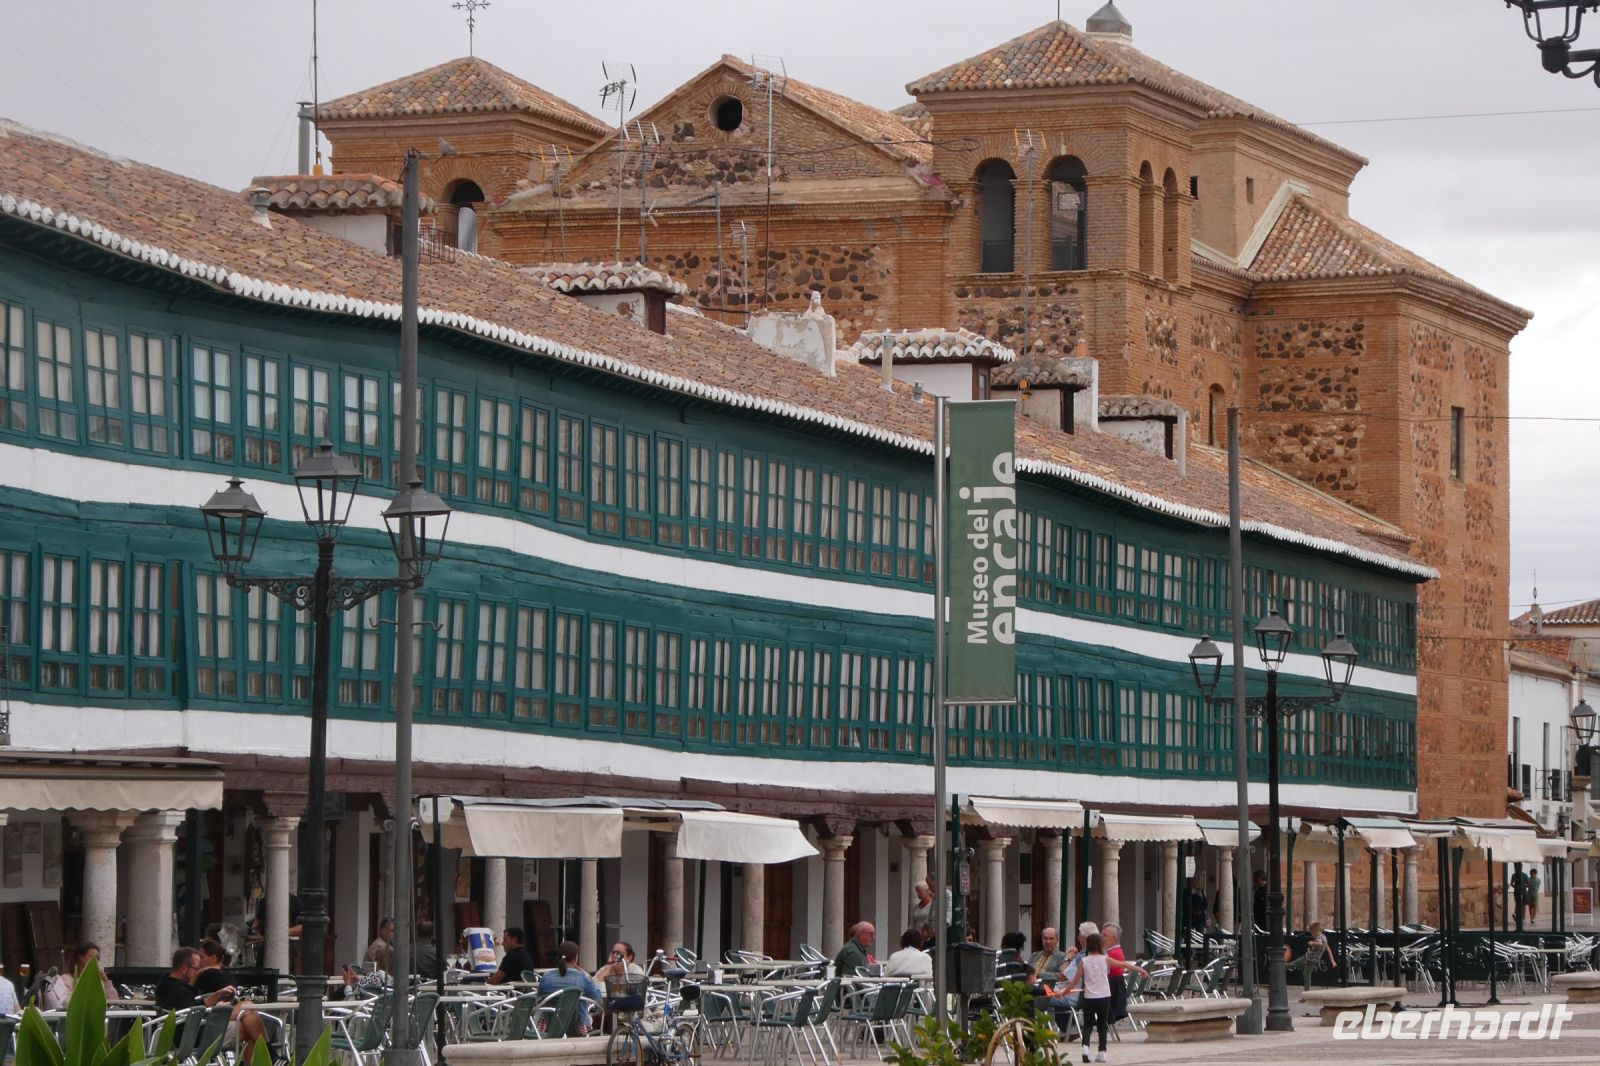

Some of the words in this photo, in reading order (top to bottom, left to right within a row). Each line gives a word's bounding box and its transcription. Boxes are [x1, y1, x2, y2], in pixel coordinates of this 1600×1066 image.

[959, 452, 1016, 645] encaje
[967, 509, 989, 550] del
[967, 556, 989, 644] Museo
